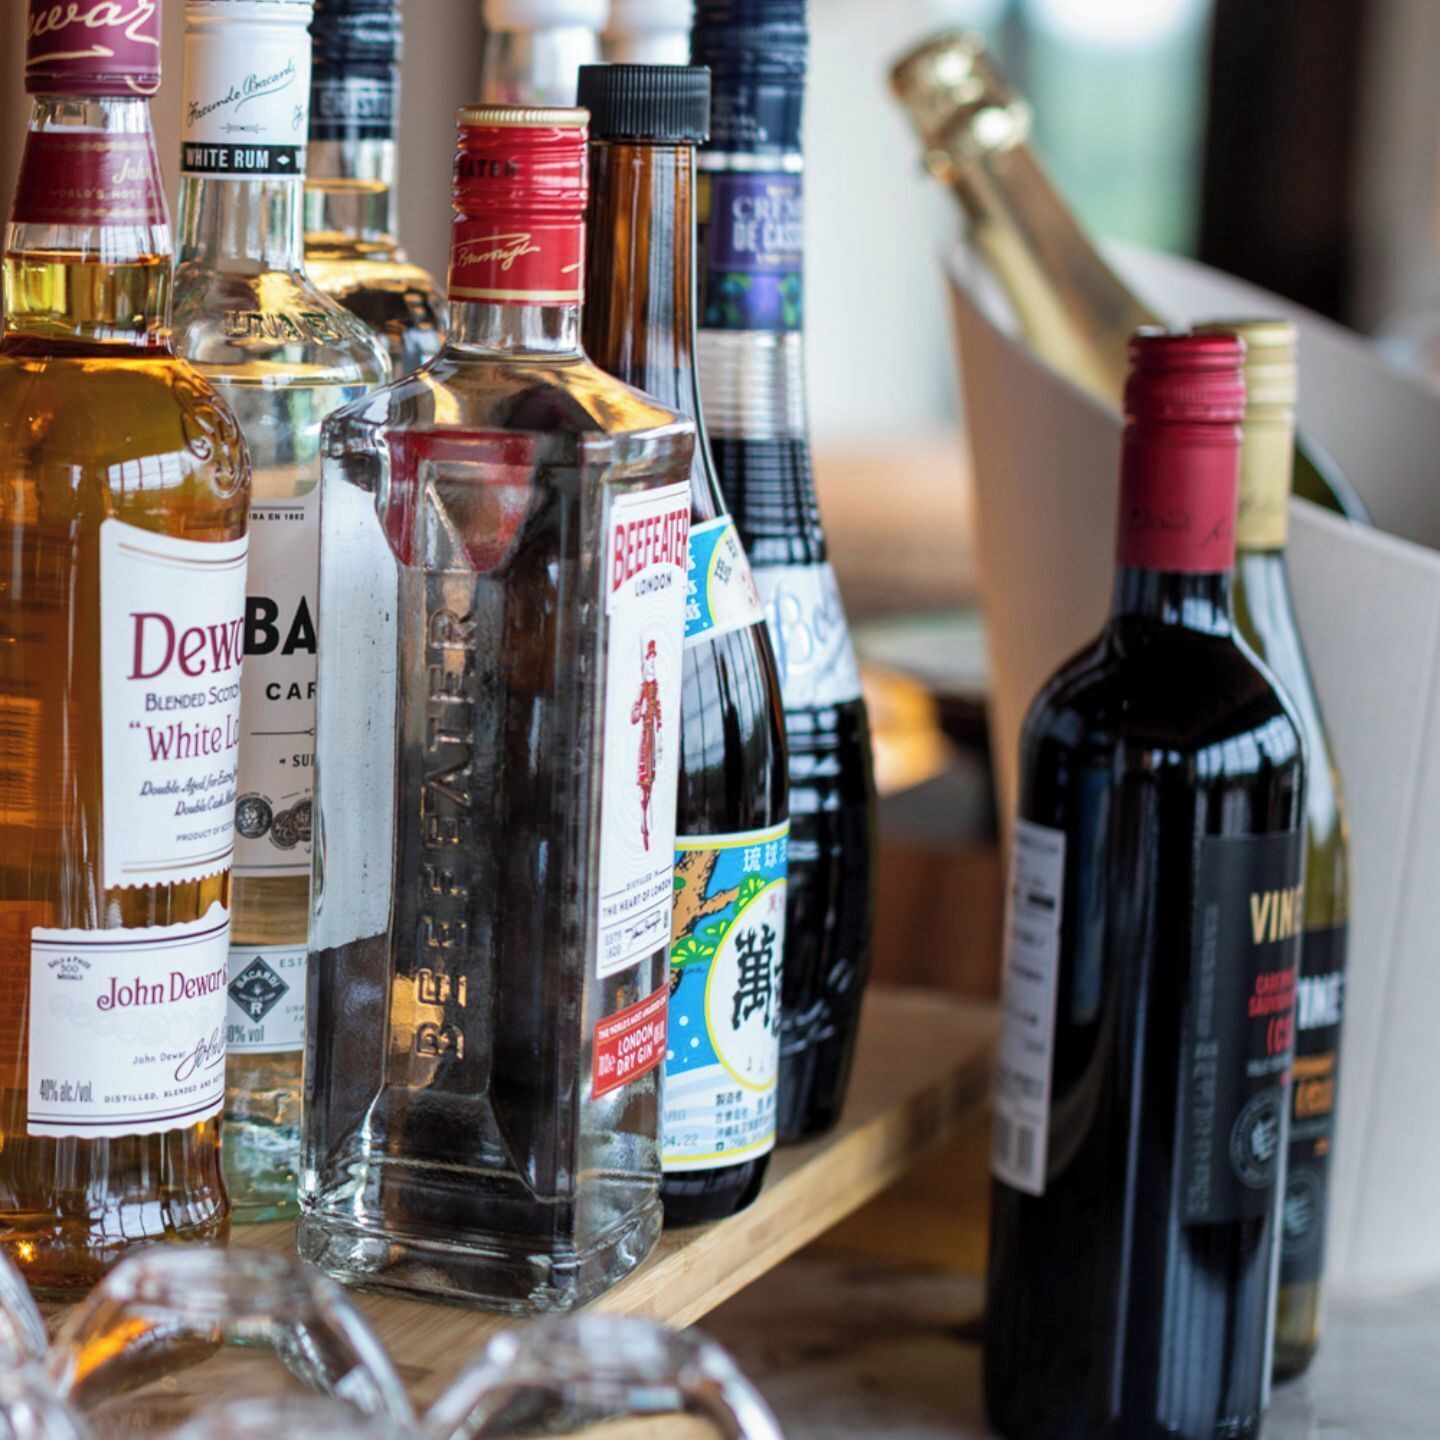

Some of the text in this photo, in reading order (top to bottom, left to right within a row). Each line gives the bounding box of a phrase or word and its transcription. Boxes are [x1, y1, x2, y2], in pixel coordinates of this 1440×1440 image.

[186, 148, 229, 168] WHITE
[234, 150, 270, 169] RUM
[612, 508, 689, 593] BEEFEATER
[634, 573, 673, 598] LONDON
[235, 968, 280, 990] BACARDI
[96, 976, 165, 1012] John
[248, 1024, 265, 1043] vol
[617, 1020, 654, 1057] LONDON
[132, 1053, 157, 1065] John
[616, 1050, 636, 1077] DRY
[637, 1041, 653, 1065] GIN
[164, 1084, 197, 1098] BLENDED
